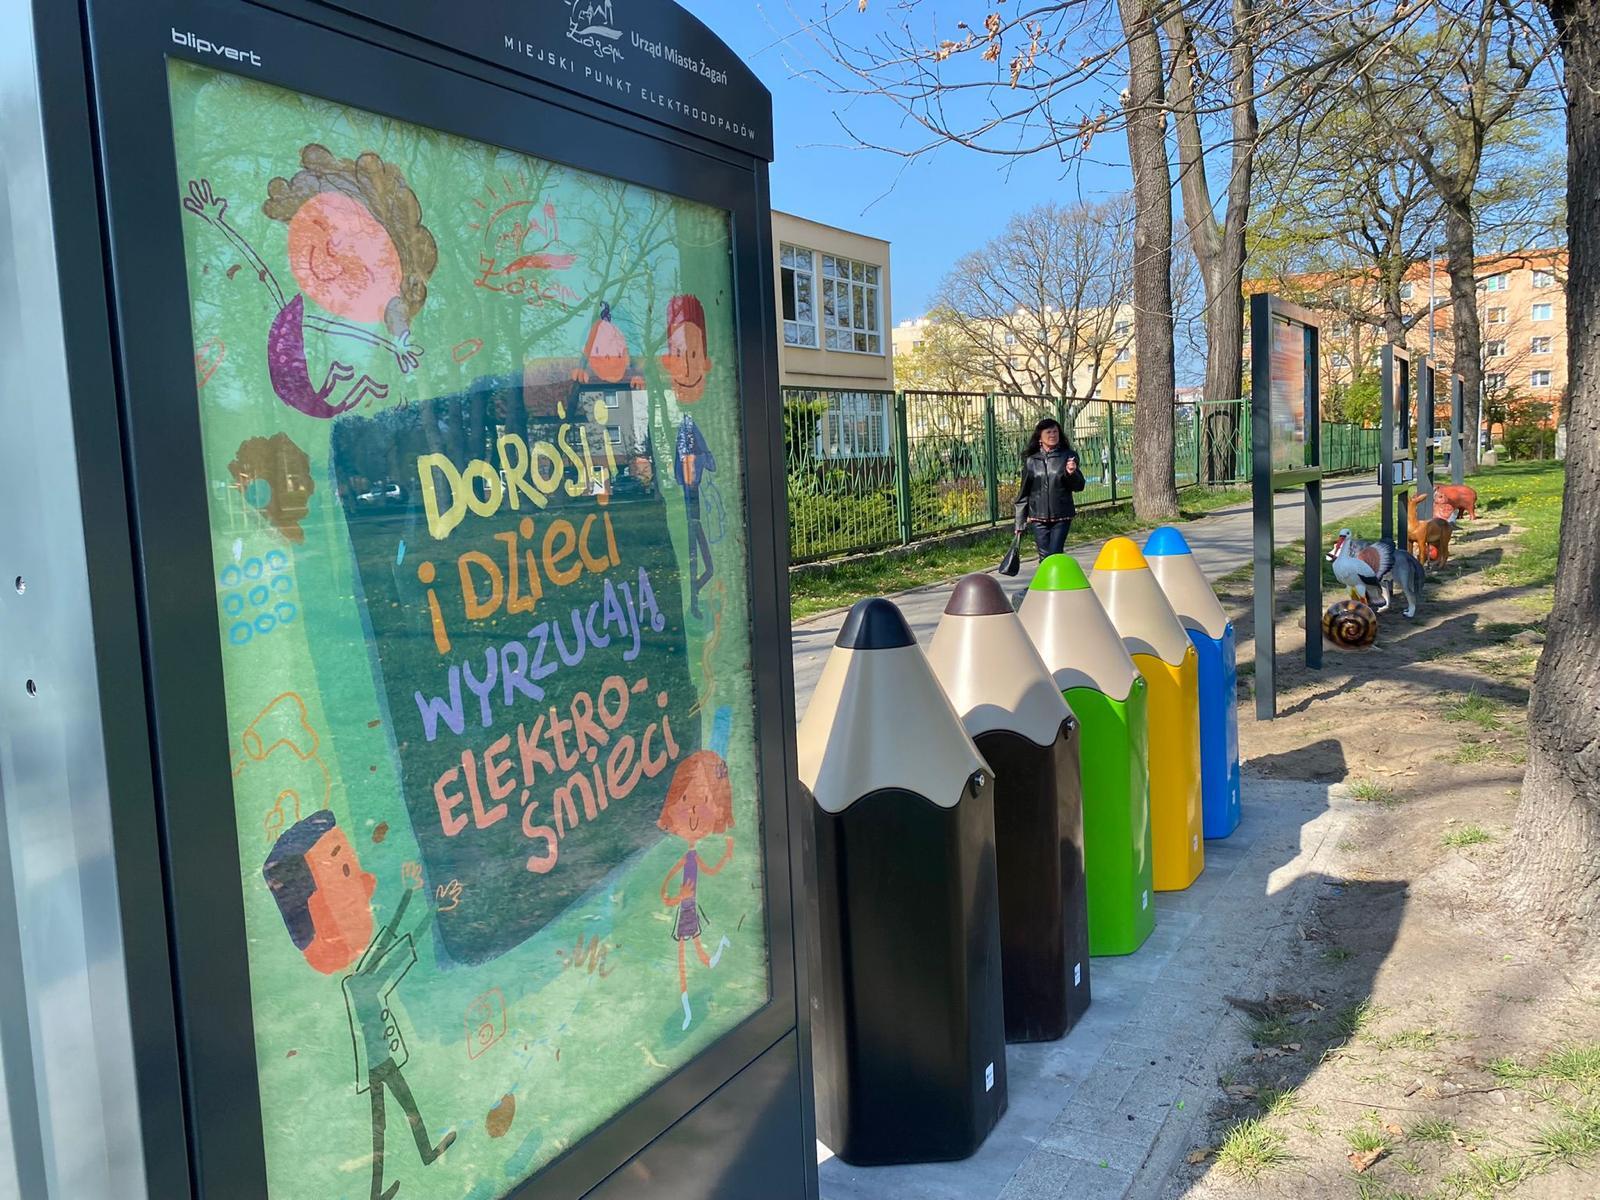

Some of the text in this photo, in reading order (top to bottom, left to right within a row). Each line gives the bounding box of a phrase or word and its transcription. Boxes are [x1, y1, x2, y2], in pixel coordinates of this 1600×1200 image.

[171, 27, 262, 67] blipvert
[631, 31, 727, 85] Urząd Miasta Żagań
[505, 36, 755, 139] MIEJSKI PUNKT ELEKTROODPADÓW
[415, 566, 665, 741] WYRZUCAJĄ
